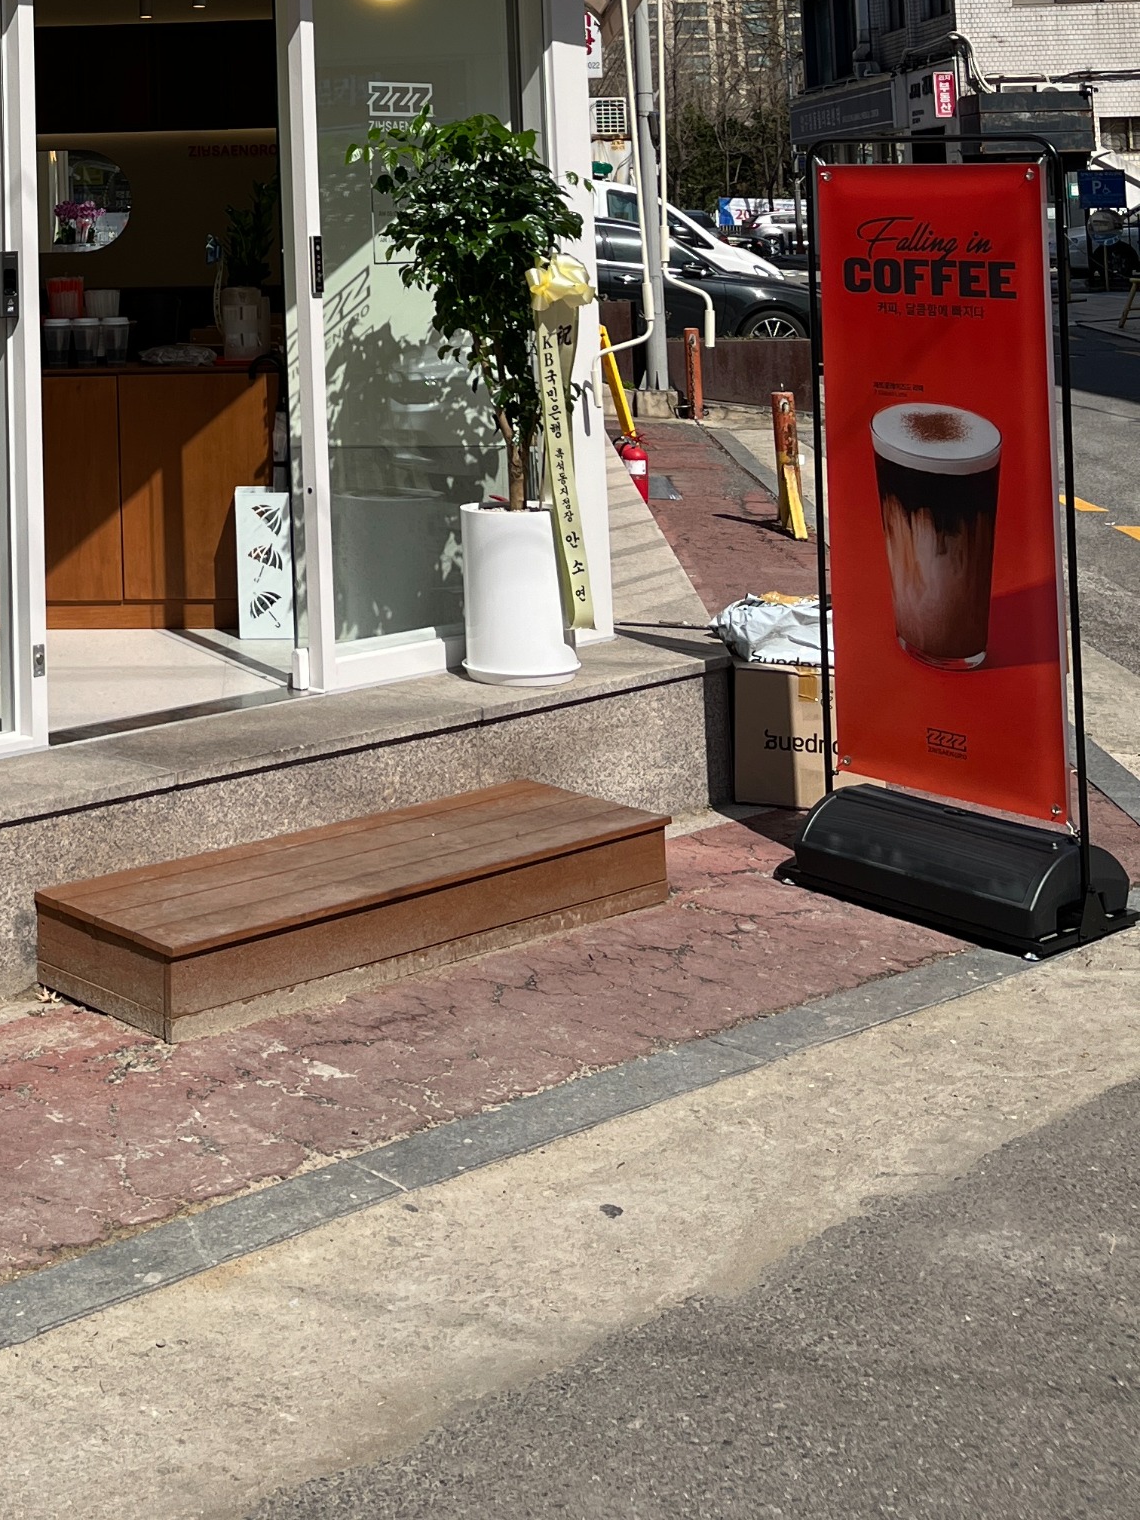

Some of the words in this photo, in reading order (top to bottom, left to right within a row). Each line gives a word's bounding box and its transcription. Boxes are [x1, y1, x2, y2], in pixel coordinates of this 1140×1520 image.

[856, 216, 958, 260] Falling
[966, 230, 992, 254] in
[843, 257, 1017, 299] COFFEE
